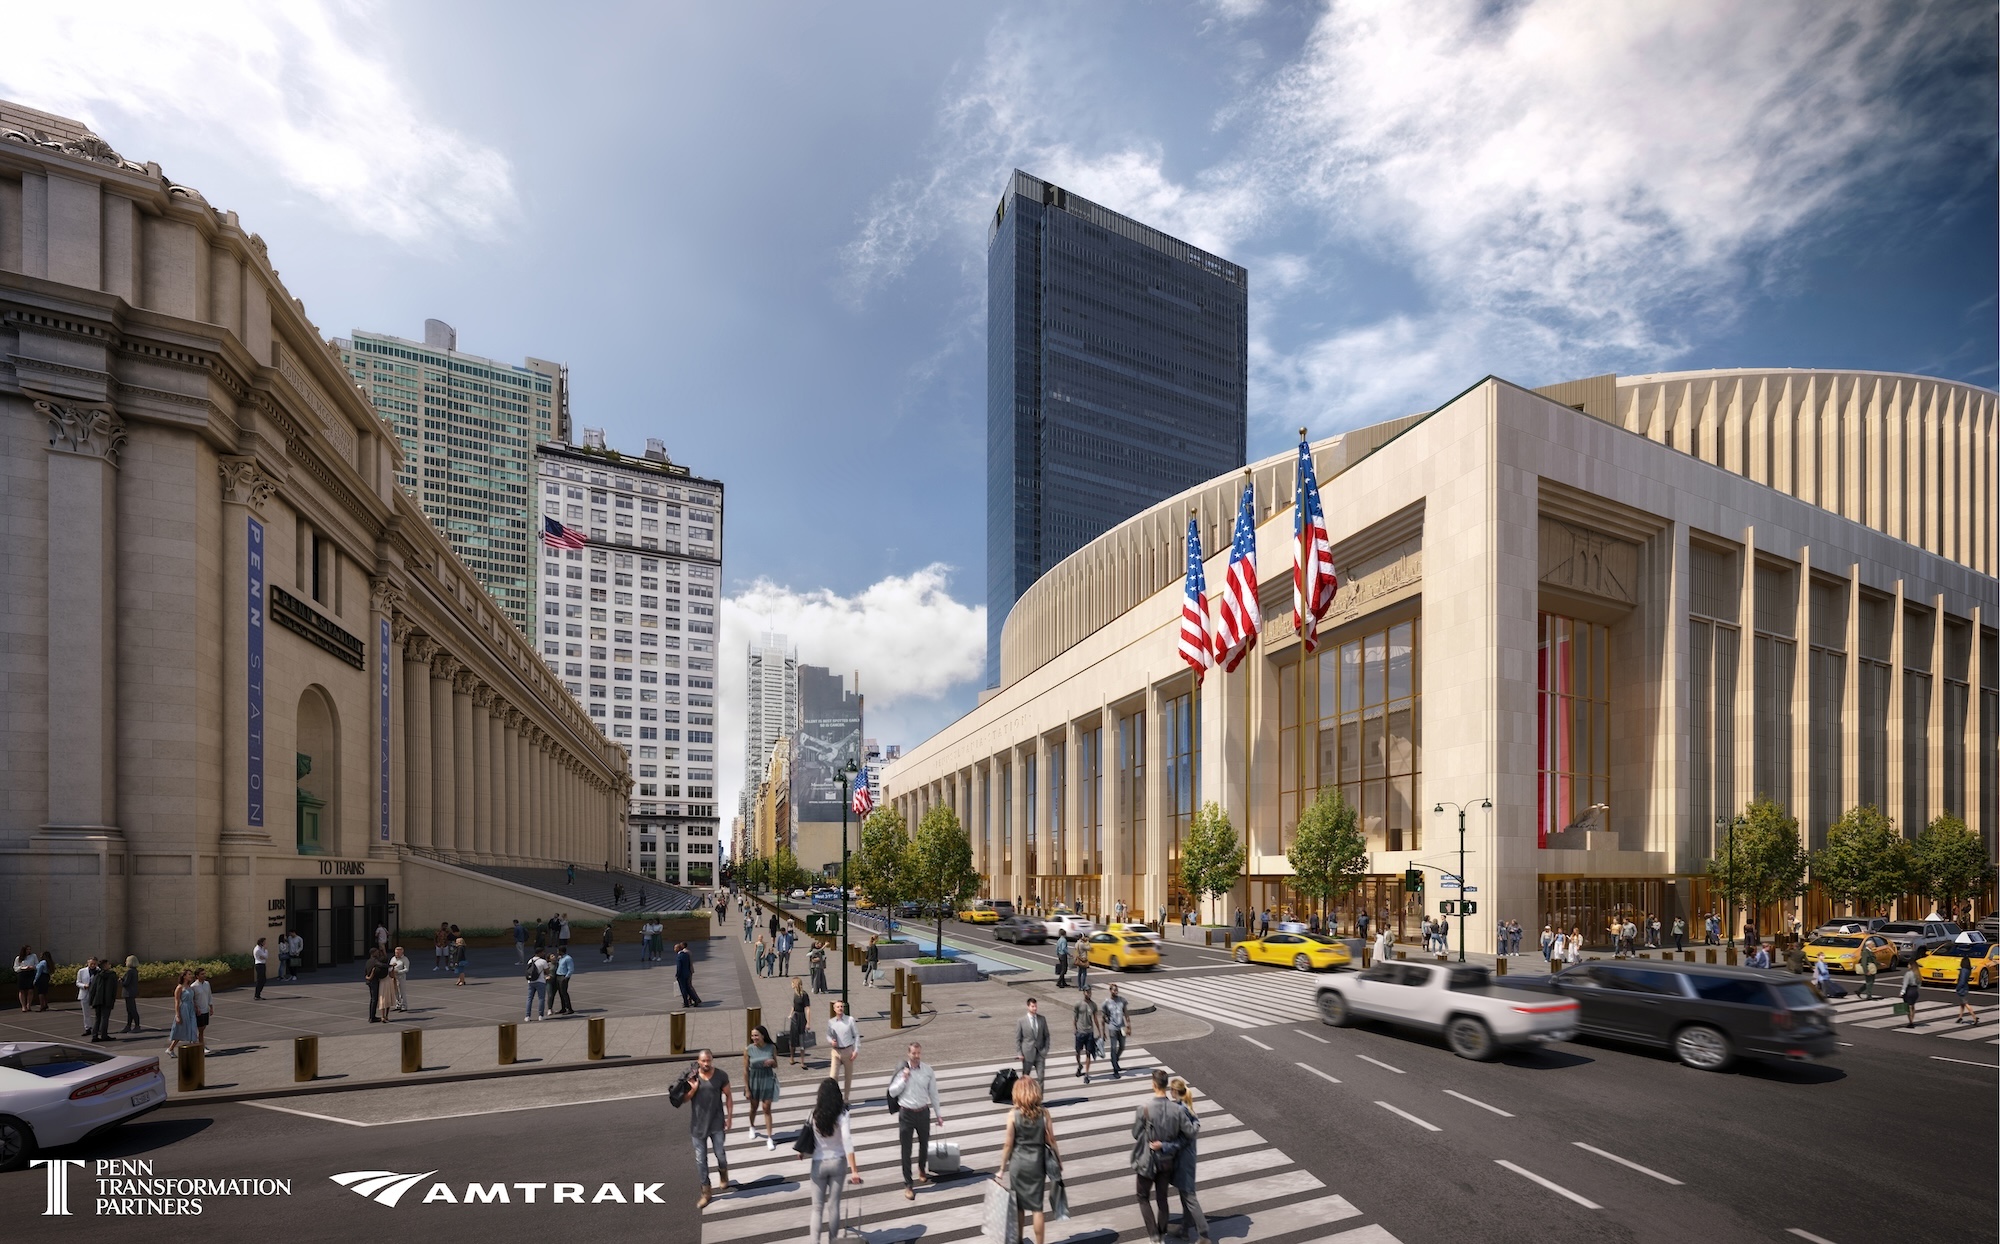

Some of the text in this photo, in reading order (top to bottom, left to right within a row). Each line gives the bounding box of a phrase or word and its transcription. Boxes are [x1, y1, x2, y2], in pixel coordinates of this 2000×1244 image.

[1049, 185, 1059, 206] 1
[251, 523, 261, 822] PENN STATION
[318, 860, 365, 875] TO TRAINS
[268, 899, 286, 911] LIRR
